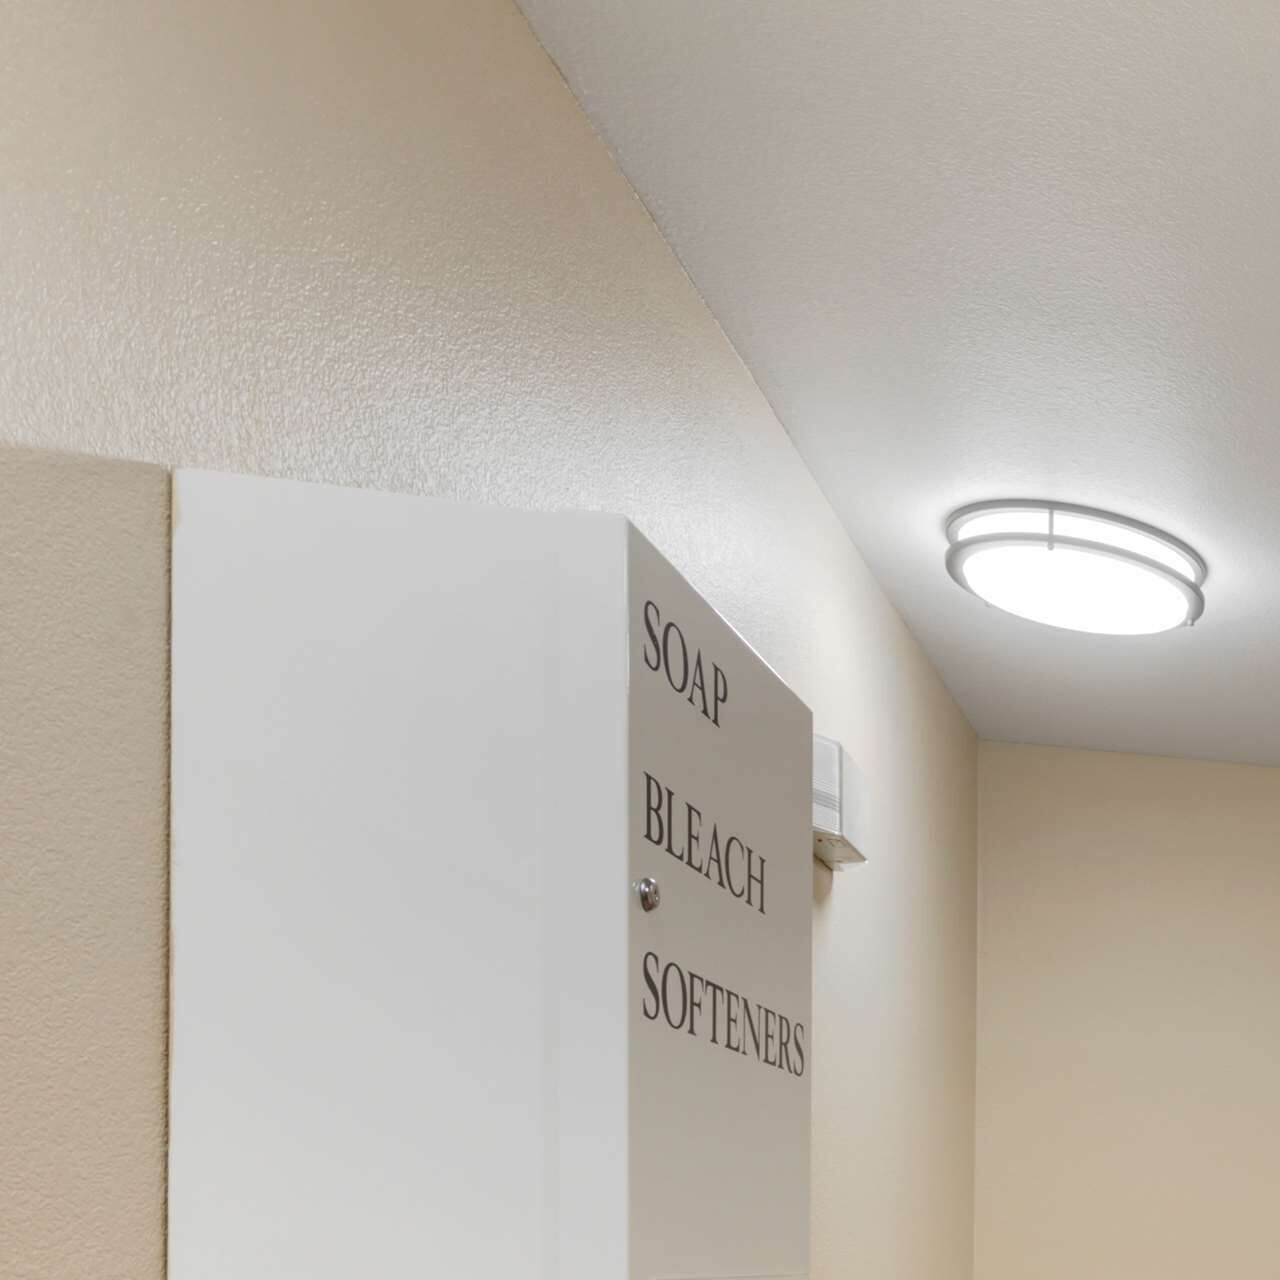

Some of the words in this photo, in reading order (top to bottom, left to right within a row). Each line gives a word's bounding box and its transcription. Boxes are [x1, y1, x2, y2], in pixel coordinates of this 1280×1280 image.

[643, 600, 728, 728] SOAP
[643, 771, 767, 915] BLEACH
[642, 951, 805, 1077] SOFTENERS
